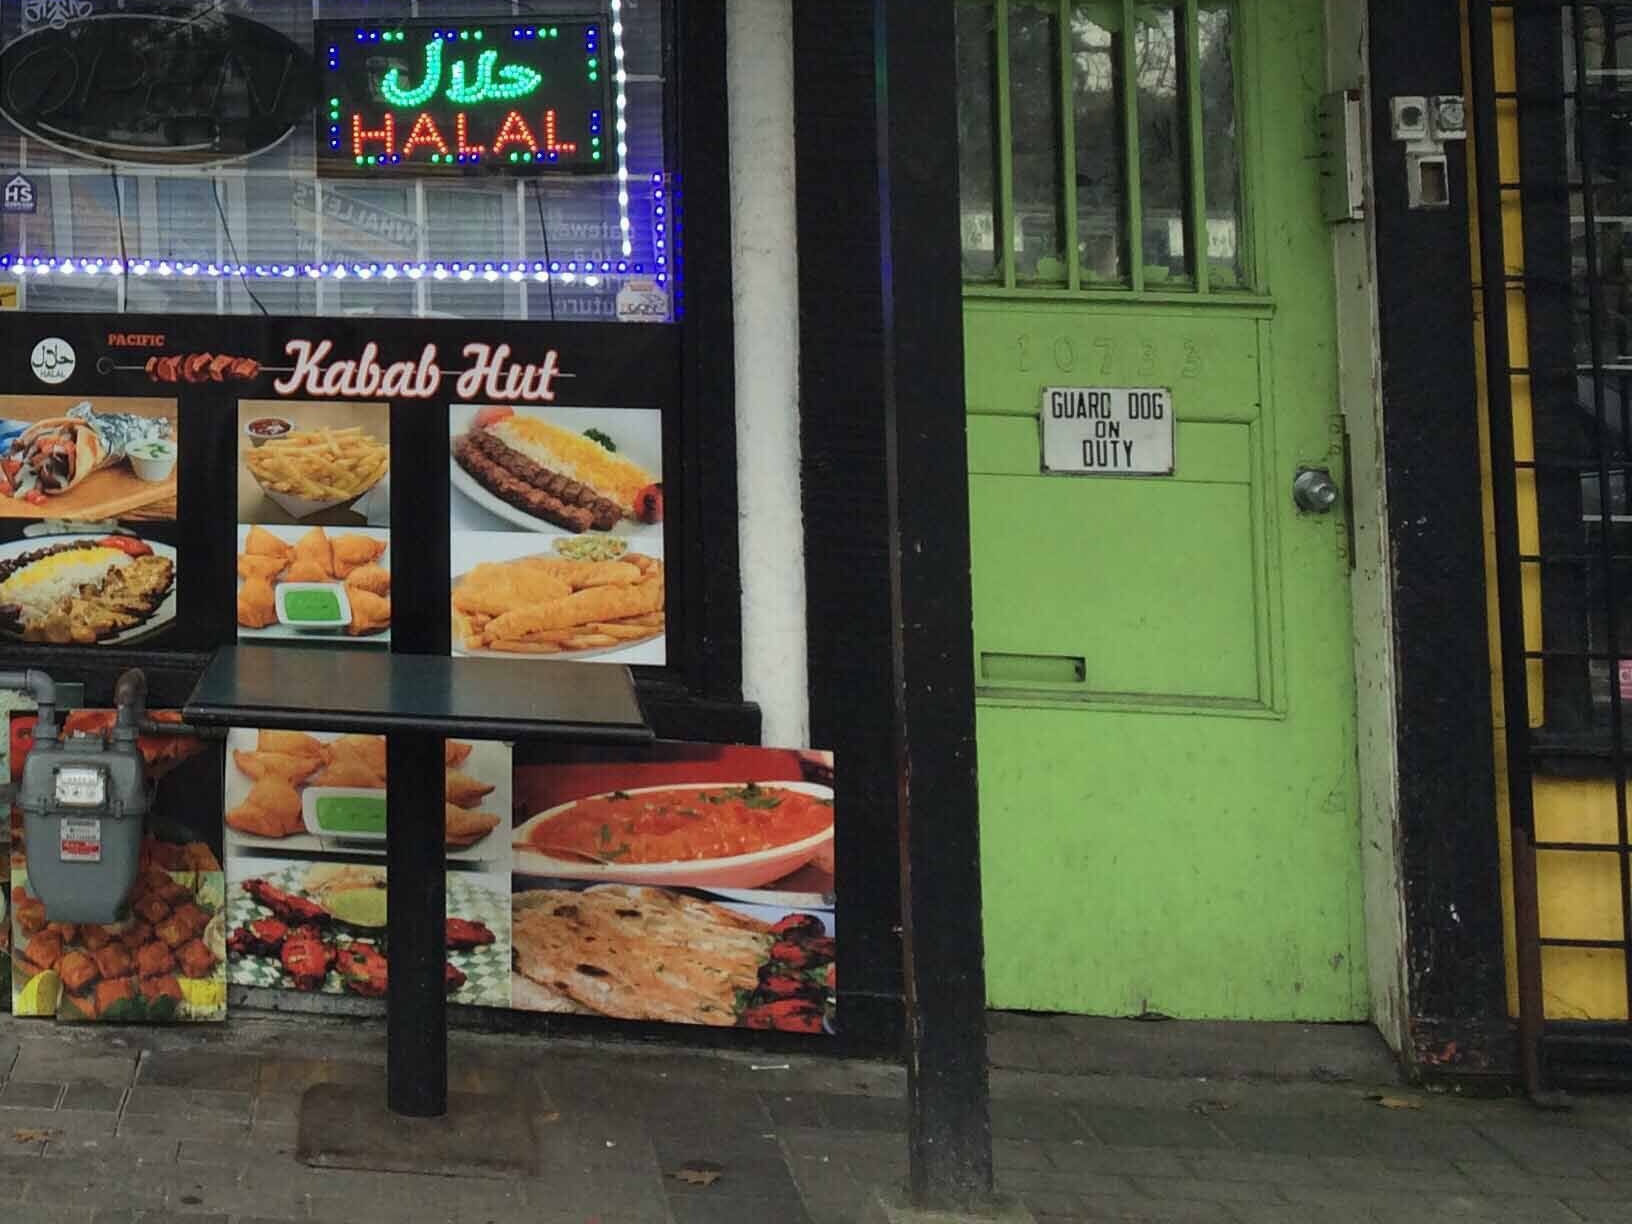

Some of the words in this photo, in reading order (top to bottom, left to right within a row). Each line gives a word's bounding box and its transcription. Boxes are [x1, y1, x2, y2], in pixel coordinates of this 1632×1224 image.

[381, 37, 542, 107] حلال
[352, 109, 577, 156] HALAL
[5, 187, 33, 201] HS
[107, 333, 167, 347] PACIFIC
[273, 338, 440, 398] Kabab
[456, 343, 559, 401] Hut
[1051, 391, 1112, 419] GUARD
[1128, 392, 1164, 420] DOG
[1095, 421, 1121, 439] ON
[1082, 440, 1134, 467] DUTY
